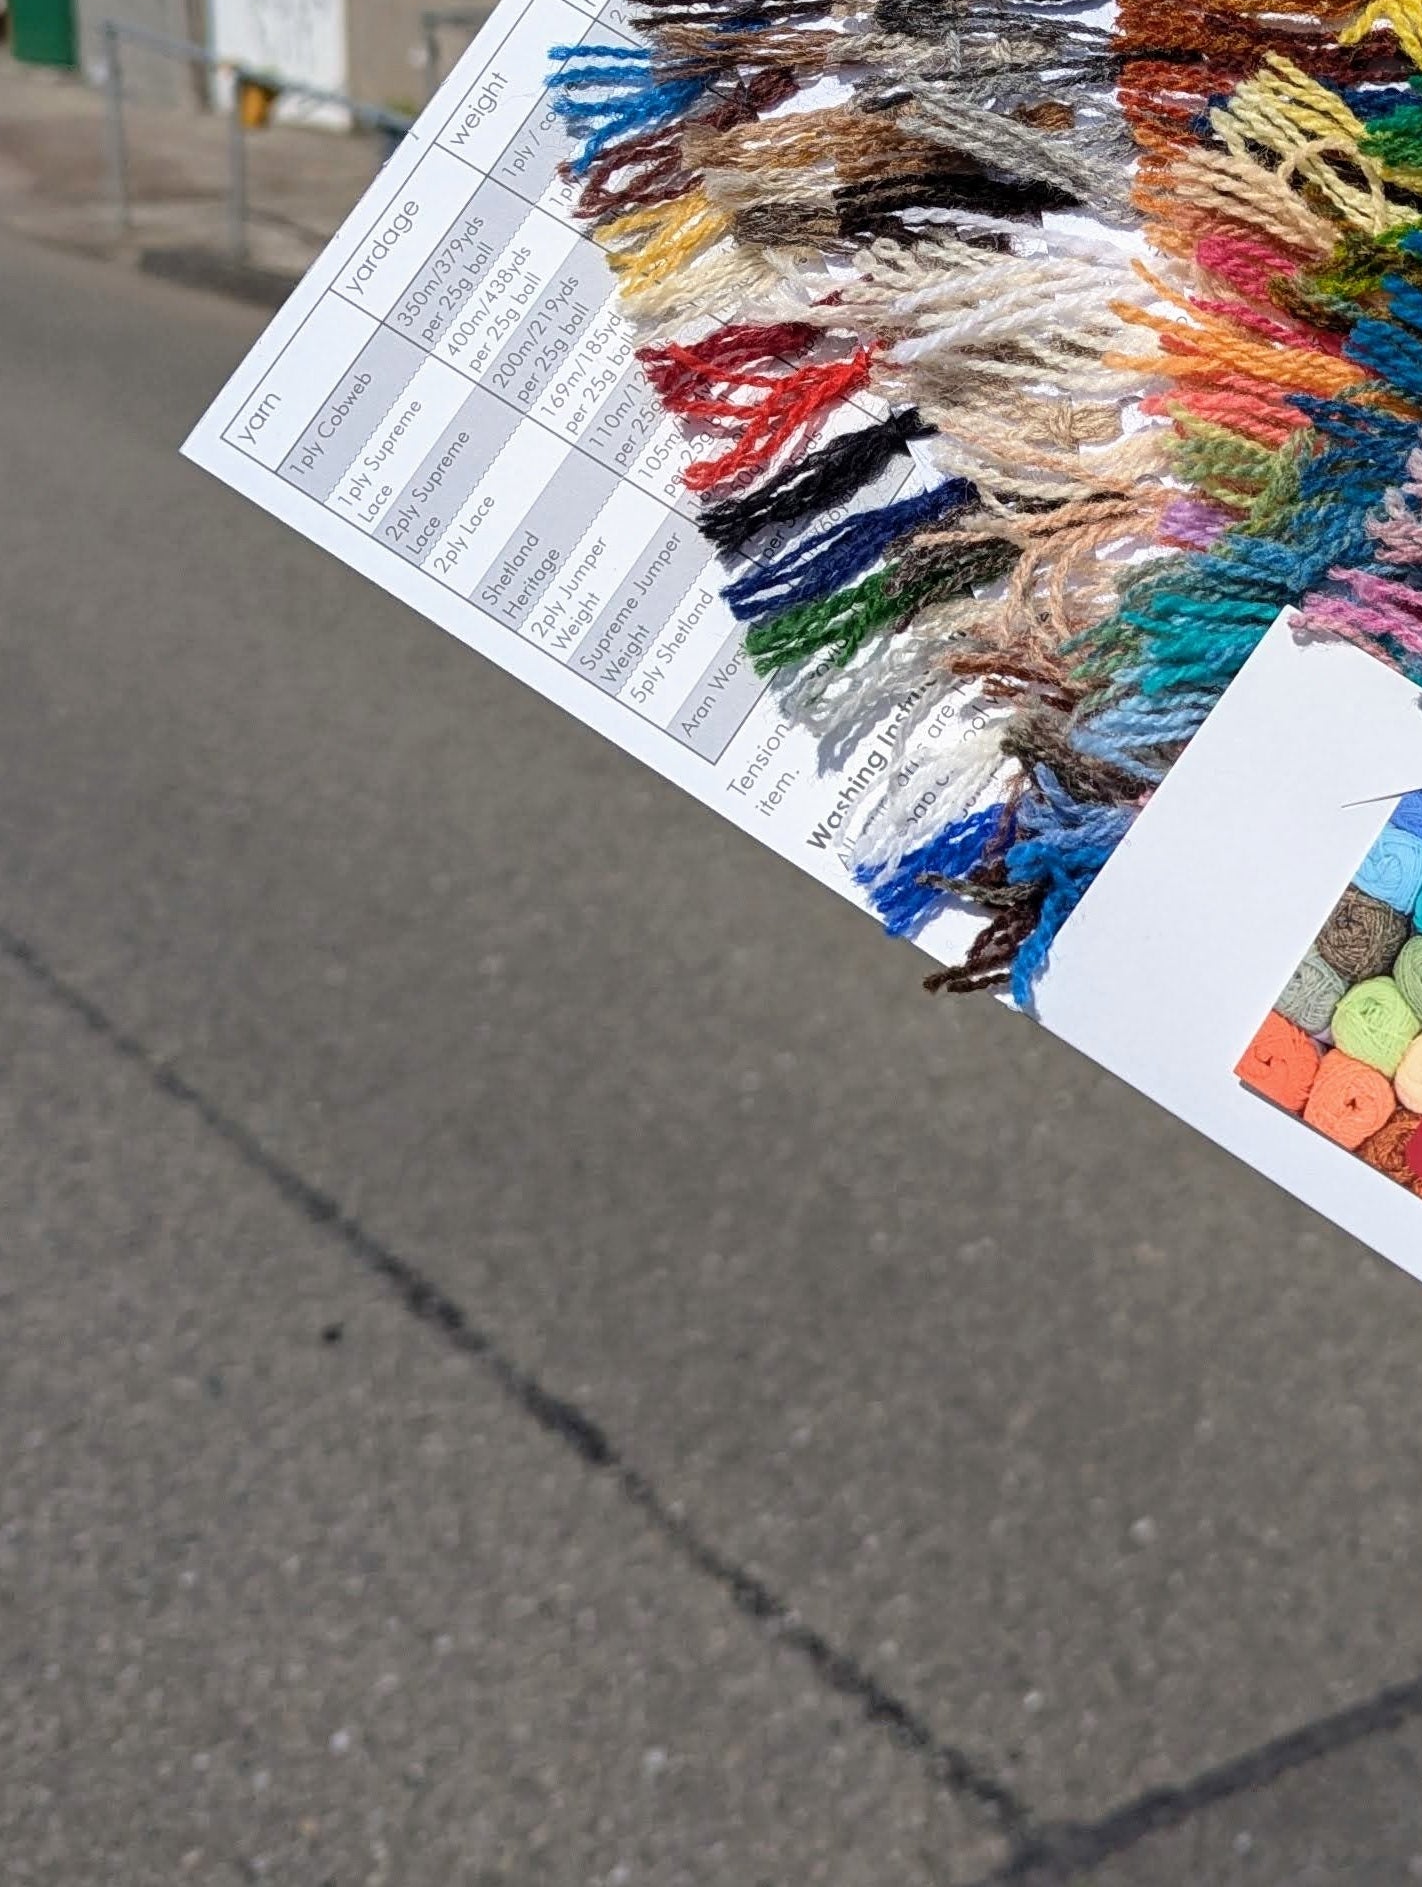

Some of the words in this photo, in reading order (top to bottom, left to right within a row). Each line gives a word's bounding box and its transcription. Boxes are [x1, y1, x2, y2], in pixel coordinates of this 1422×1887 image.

[449, 72, 508, 144] weight
[501, 141, 535, 176] 1ply
[346, 201, 419, 295] yardage
[395, 210, 484, 327] 350m/379yds
[419, 313, 448, 345] per
[439, 274, 476, 315] 25g
[462, 238, 496, 277] ball
[448, 247, 531, 356] 400m/438yds
[468, 343, 491, 373] per
[486, 308, 520, 342] 25g
[510, 272, 541, 305] ball
[492, 274, 580, 395] 200m/219yds
[514, 373, 546, 405] per
[534, 332, 572, 377] 25g
[558, 300, 591, 336] ball
[237, 394, 281, 445] yarn
[288, 440, 327, 474] 1ply
[317, 367, 371, 438] Cobweb
[565, 405, 588, 436] per
[583, 369, 617, 403] 25g
[338, 473, 372, 506] 1ply
[364, 401, 421, 471] Supreme
[385, 502, 423, 545] 2ply
[412, 432, 469, 503] Supreme
[610, 434, 642, 469] per
[661, 465, 692, 500] per
[680, 427, 717, 468] 25g
[357, 480, 392, 523] Lace
[406, 513, 444, 558] Lace
[434, 536, 468, 574] 2ply
[459, 497, 494, 534] Lace
[482, 530, 540, 608] Shetland
[500, 548, 567, 623] Heritage
[531, 600, 566, 639] 2ply
[559, 536, 606, 600] Jumper
[579, 595, 638, 672] Supreme
[633, 532, 681, 596] Jumper
[551, 592, 600, 649] Weight
[600, 624, 656, 690] Weight
[631, 666, 665, 704] 5ply
[656, 588, 714, 664] Shetland
[680, 696, 716, 738] Aran
[923, 700, 958, 741] are
[725, 717, 792, 801] Tension
[755, 770, 800, 816] item.
[805, 746, 889, 855] Washing
